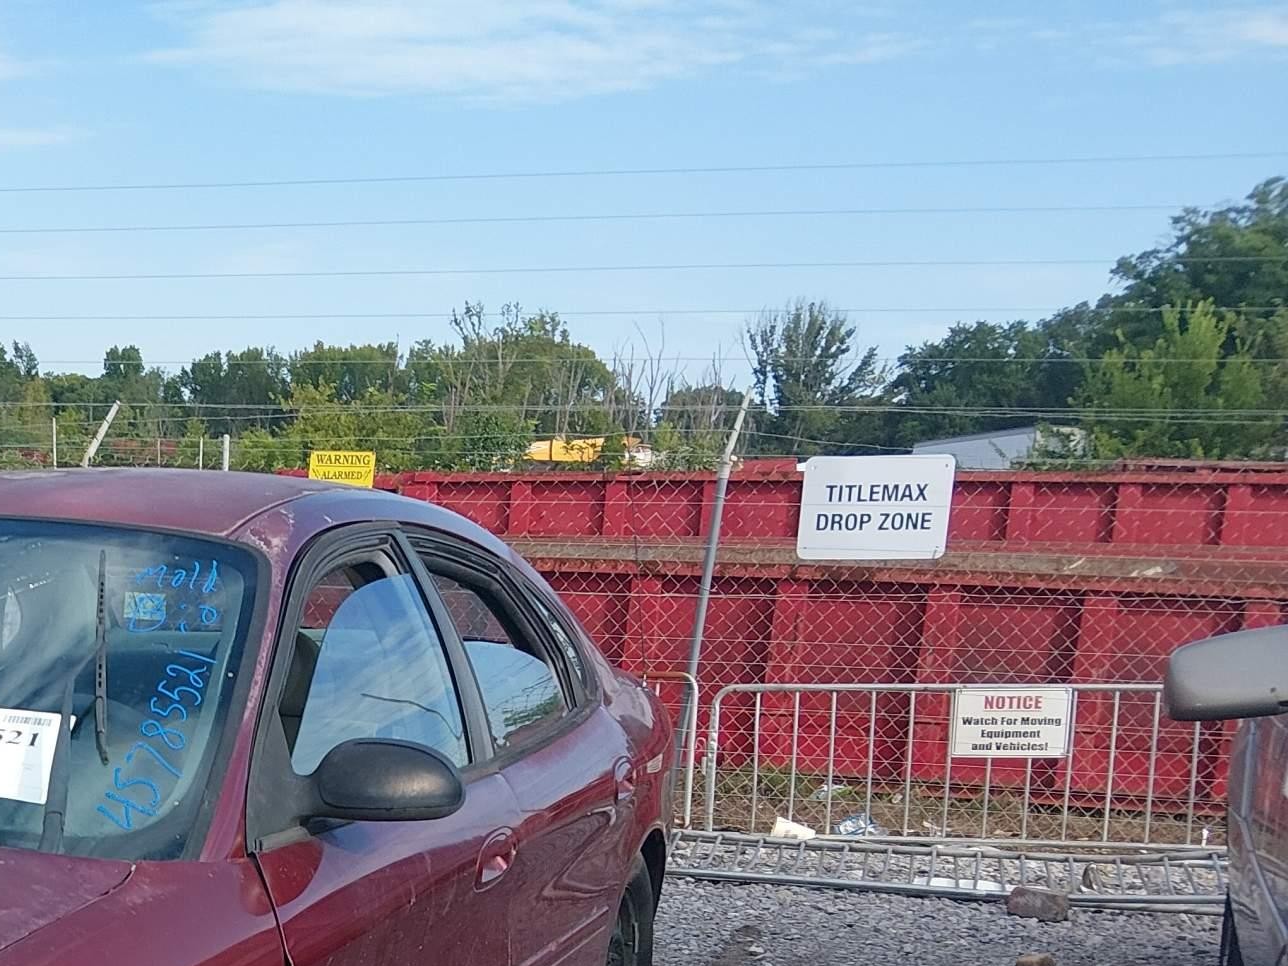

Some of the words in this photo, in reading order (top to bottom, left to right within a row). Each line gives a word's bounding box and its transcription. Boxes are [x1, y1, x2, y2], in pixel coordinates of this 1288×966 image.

[316, 454, 371, 465] WARNING
[321, 470, 364, 480] ALARMED
[826, 483, 929, 503] TITLEMAX
[815, 513, 872, 531] DROP
[878, 512, 933, 530] ZONE
[983, 695, 1044, 710] NOTICE
[962, 717, 998, 726] Watch
[1000, 717, 1018, 726] For
[1020, 717, 1062, 727] Moving
[96, 649, 217, 830] 45785521
[980, 729, 1041, 739] Equipment
[971, 742, 992, 751] and
[995, 742, 1049, 751] Vehicles!
